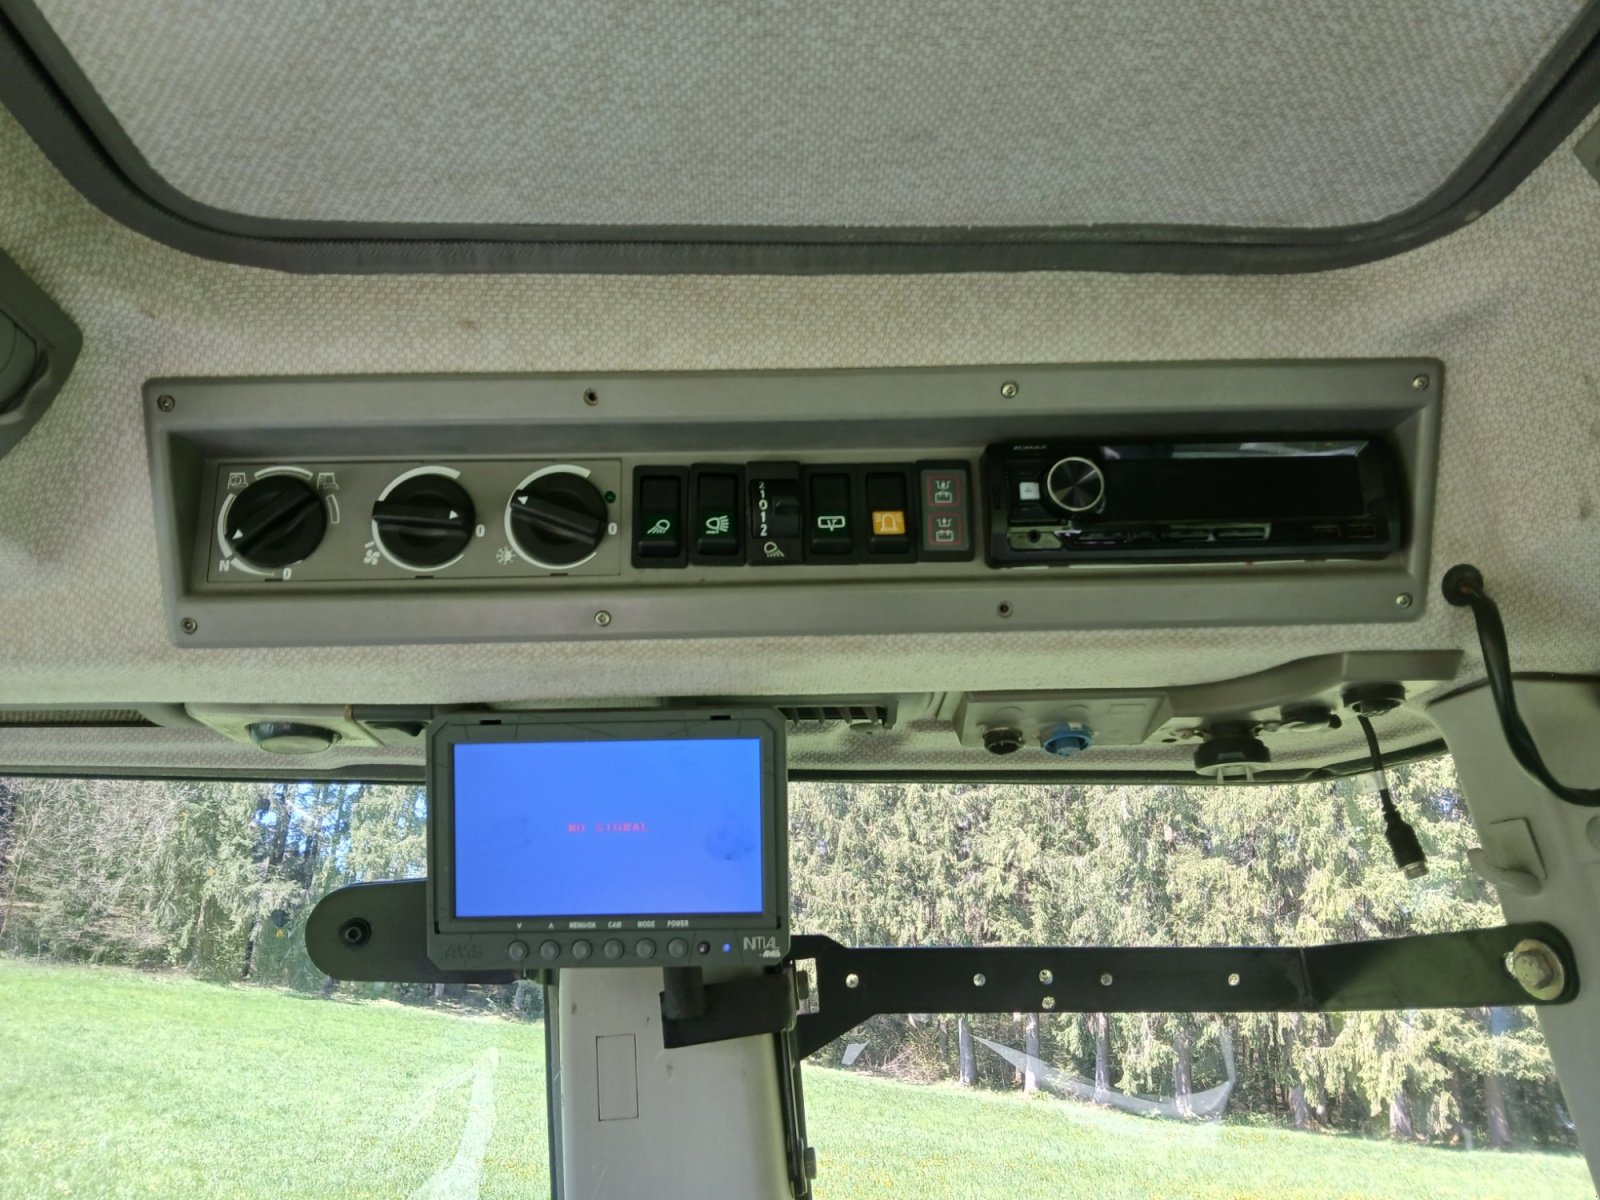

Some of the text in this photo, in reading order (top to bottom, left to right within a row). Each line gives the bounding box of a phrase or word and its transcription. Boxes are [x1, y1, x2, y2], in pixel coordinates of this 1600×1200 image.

[760, 489, 765, 498] 1
[758, 499, 768, 510] 0
[760, 511, 766, 523] 1
[475, 524, 486, 537] 0
[607, 522, 617, 535] 0
[760, 523, 768, 537] 2
[219, 559, 230, 572] N
[282, 567, 292, 580] 0
[567, 822, 648, 833] NO SIGNAL
[607, 921, 623, 929] CAM
[637, 920, 656, 929] MODE
[666, 919, 690, 929] POWER
